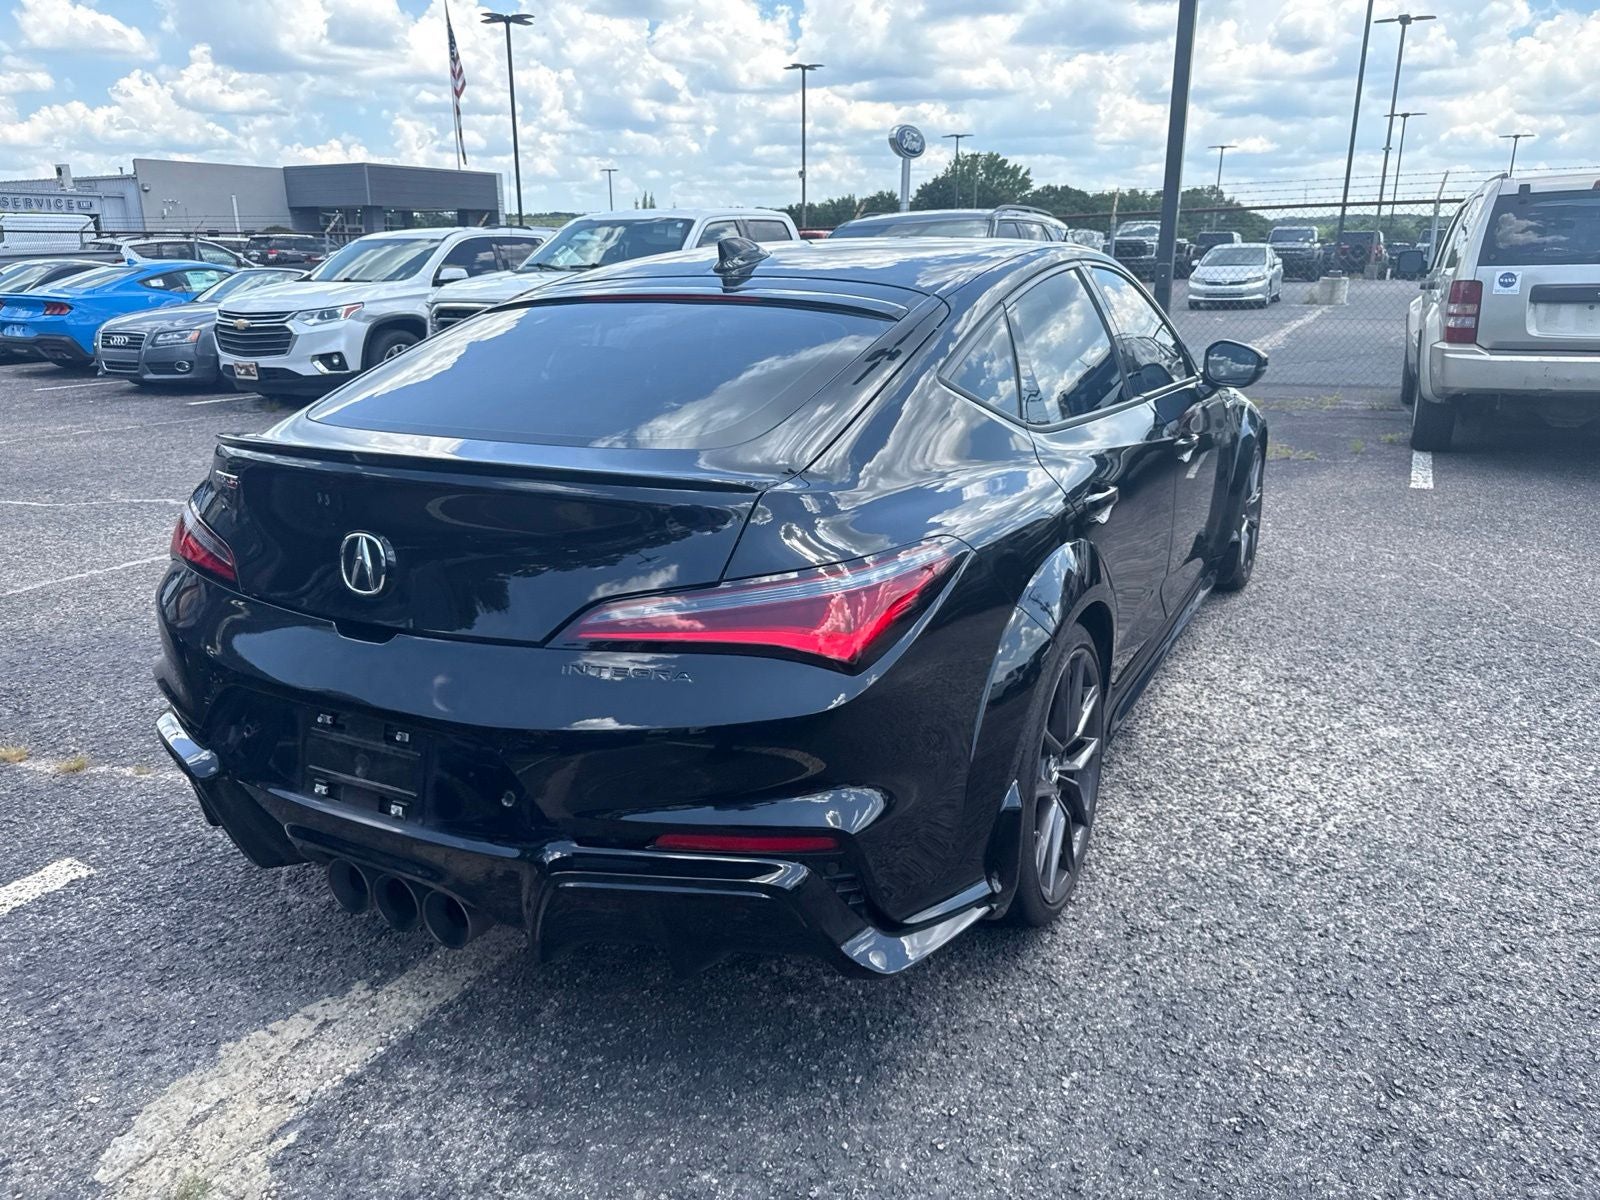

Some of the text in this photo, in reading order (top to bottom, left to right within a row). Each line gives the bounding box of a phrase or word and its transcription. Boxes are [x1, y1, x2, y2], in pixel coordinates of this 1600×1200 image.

[902, 130, 922, 152] Ford
[1, 196, 75, 210] SERVICE
[561, 663, 692, 682] INTEGRA
